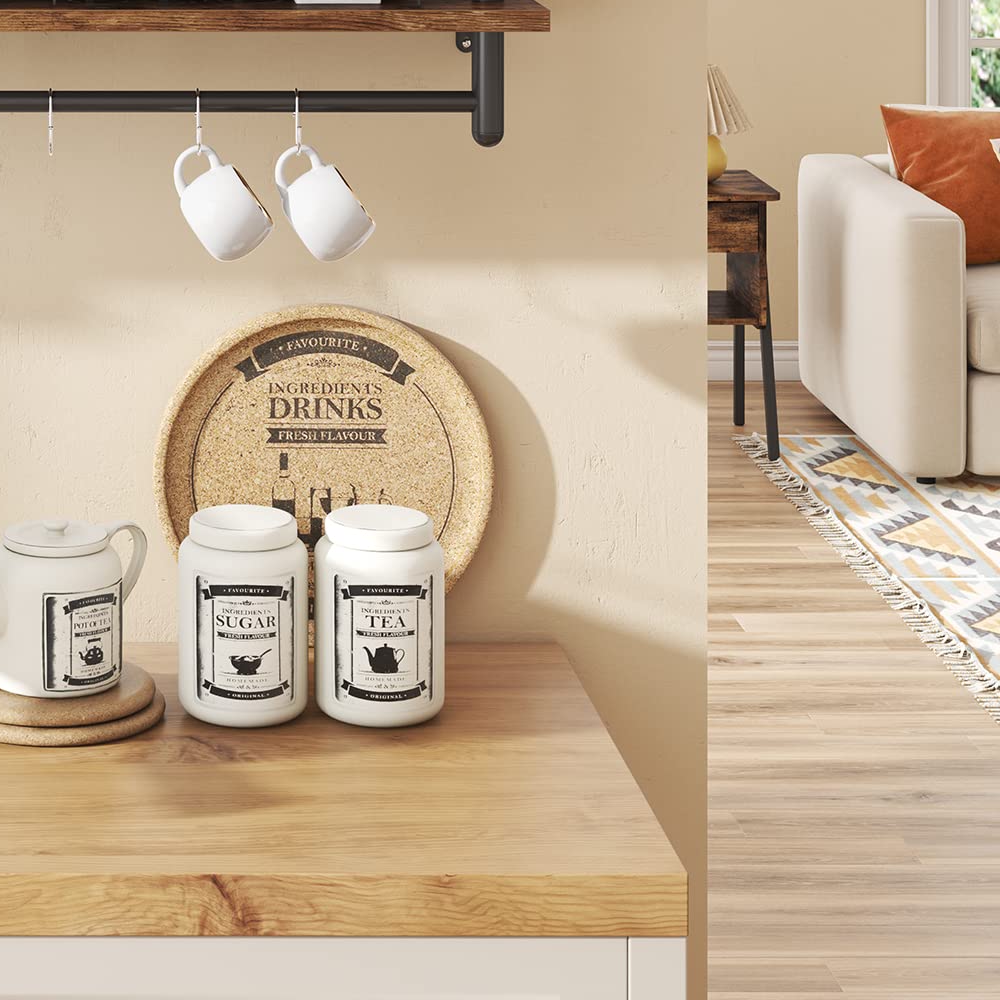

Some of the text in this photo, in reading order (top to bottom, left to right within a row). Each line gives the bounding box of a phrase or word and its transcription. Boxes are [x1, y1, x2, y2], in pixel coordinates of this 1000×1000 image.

[286, 337, 360, 351] FAVOURITE
[269, 382, 383, 395] INGREDIENTS
[268, 397, 383, 420] DRINKS
[278, 430, 376, 440] FRESH FLAVOUR
[216, 615, 276, 629] SUGAR
[365, 615, 406, 628] TEA
